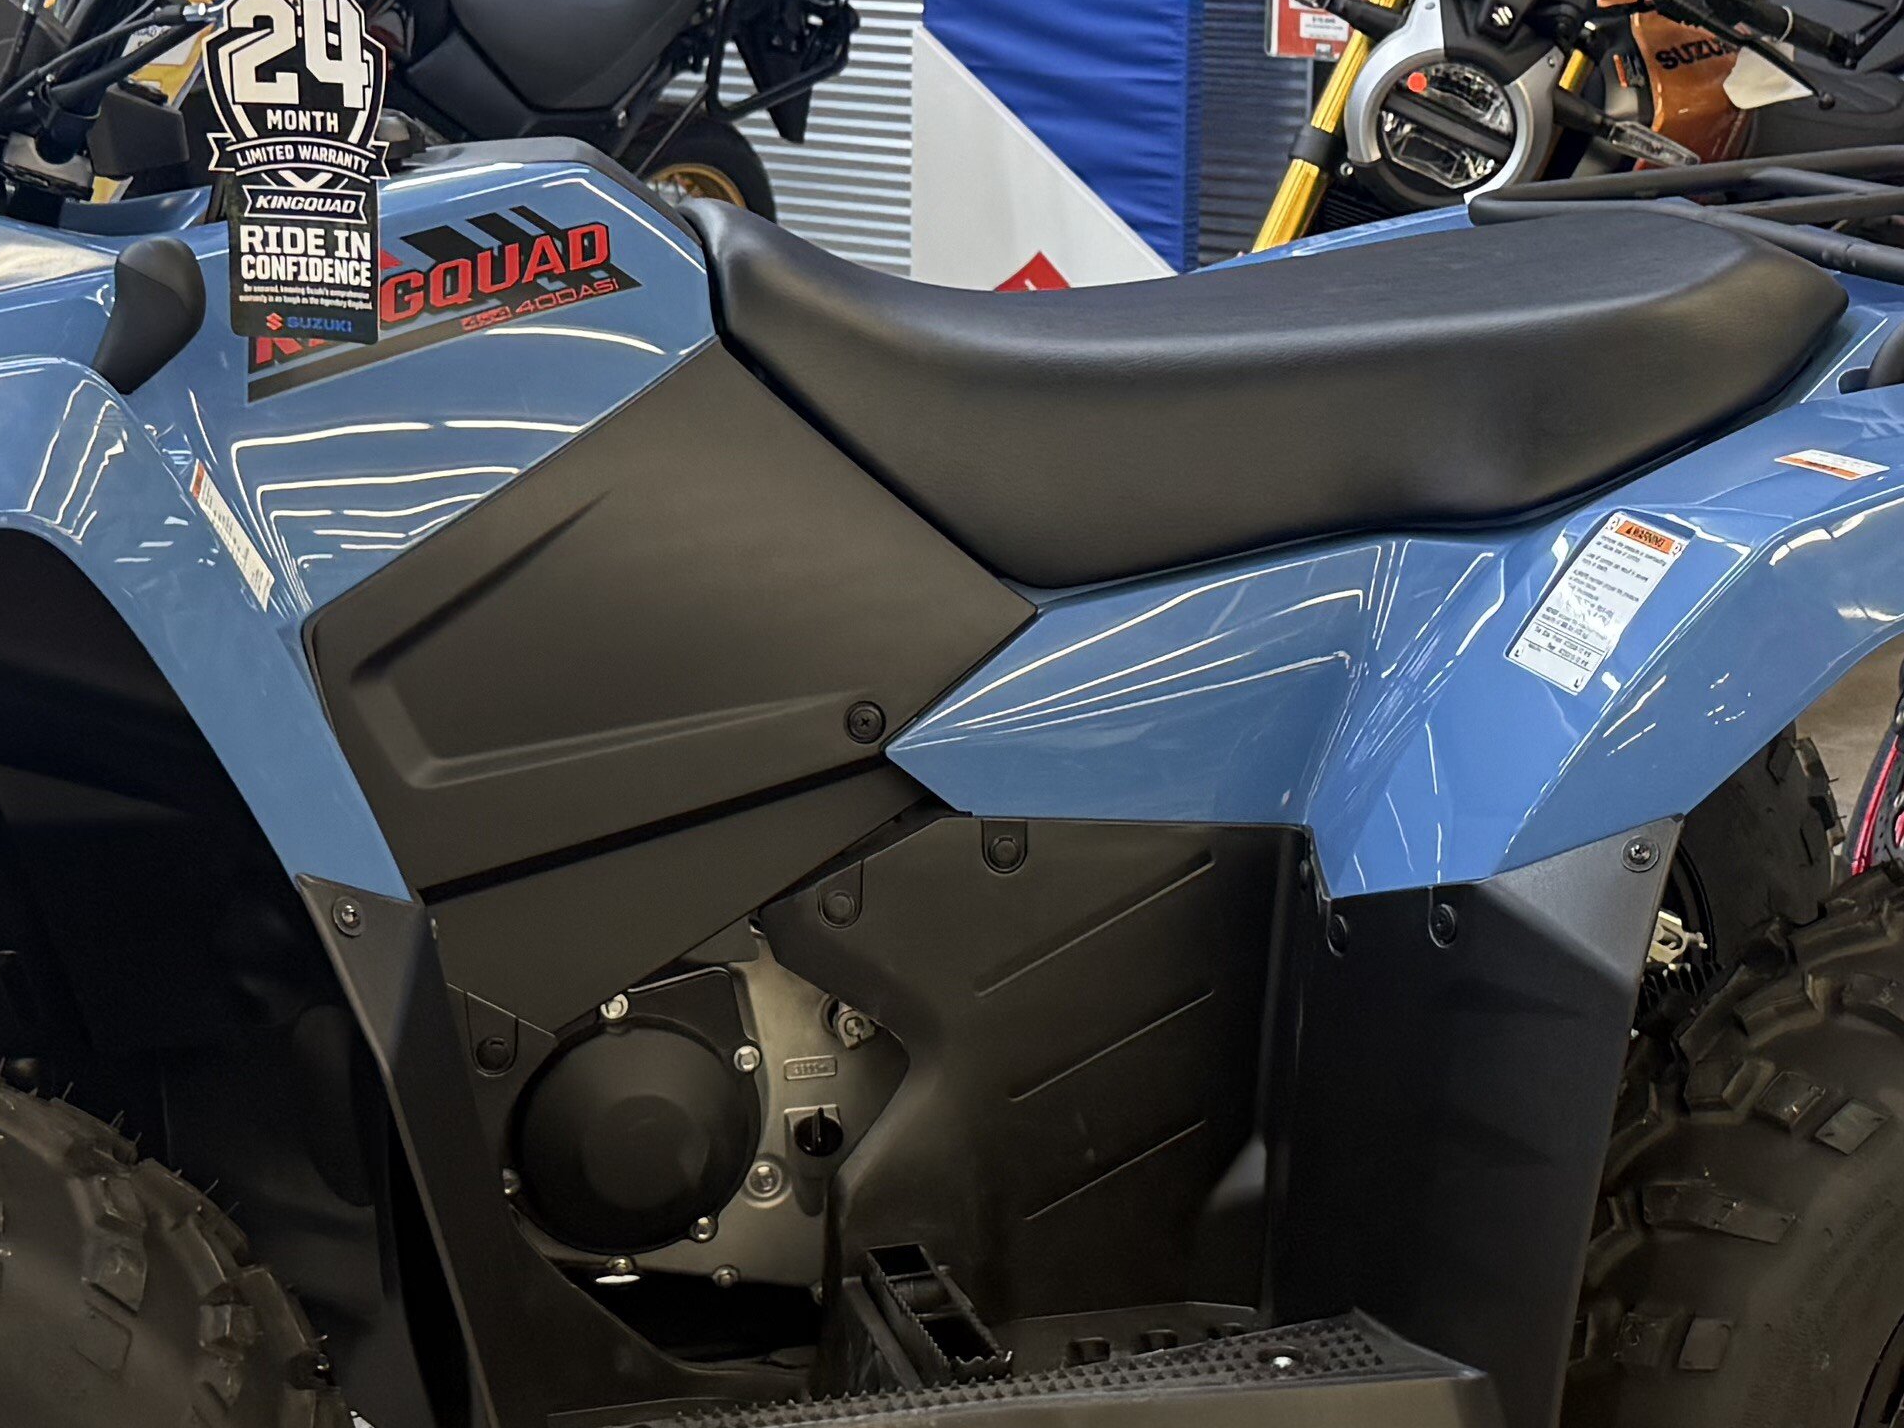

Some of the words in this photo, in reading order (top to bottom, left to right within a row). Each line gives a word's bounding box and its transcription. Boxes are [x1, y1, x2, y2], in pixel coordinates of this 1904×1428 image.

[266, 108, 339, 133] MONTH
[236, 144, 295, 167] LIMITED
[298, 144, 370, 173] WARRANTY
[255, 195, 356, 214] KINGQUAD
[239, 225, 326, 256] RIDE
[334, 229, 371, 260] IN
[240, 255, 372, 287] CONFIDENCE
[287, 316, 352, 332] SUZUKI
